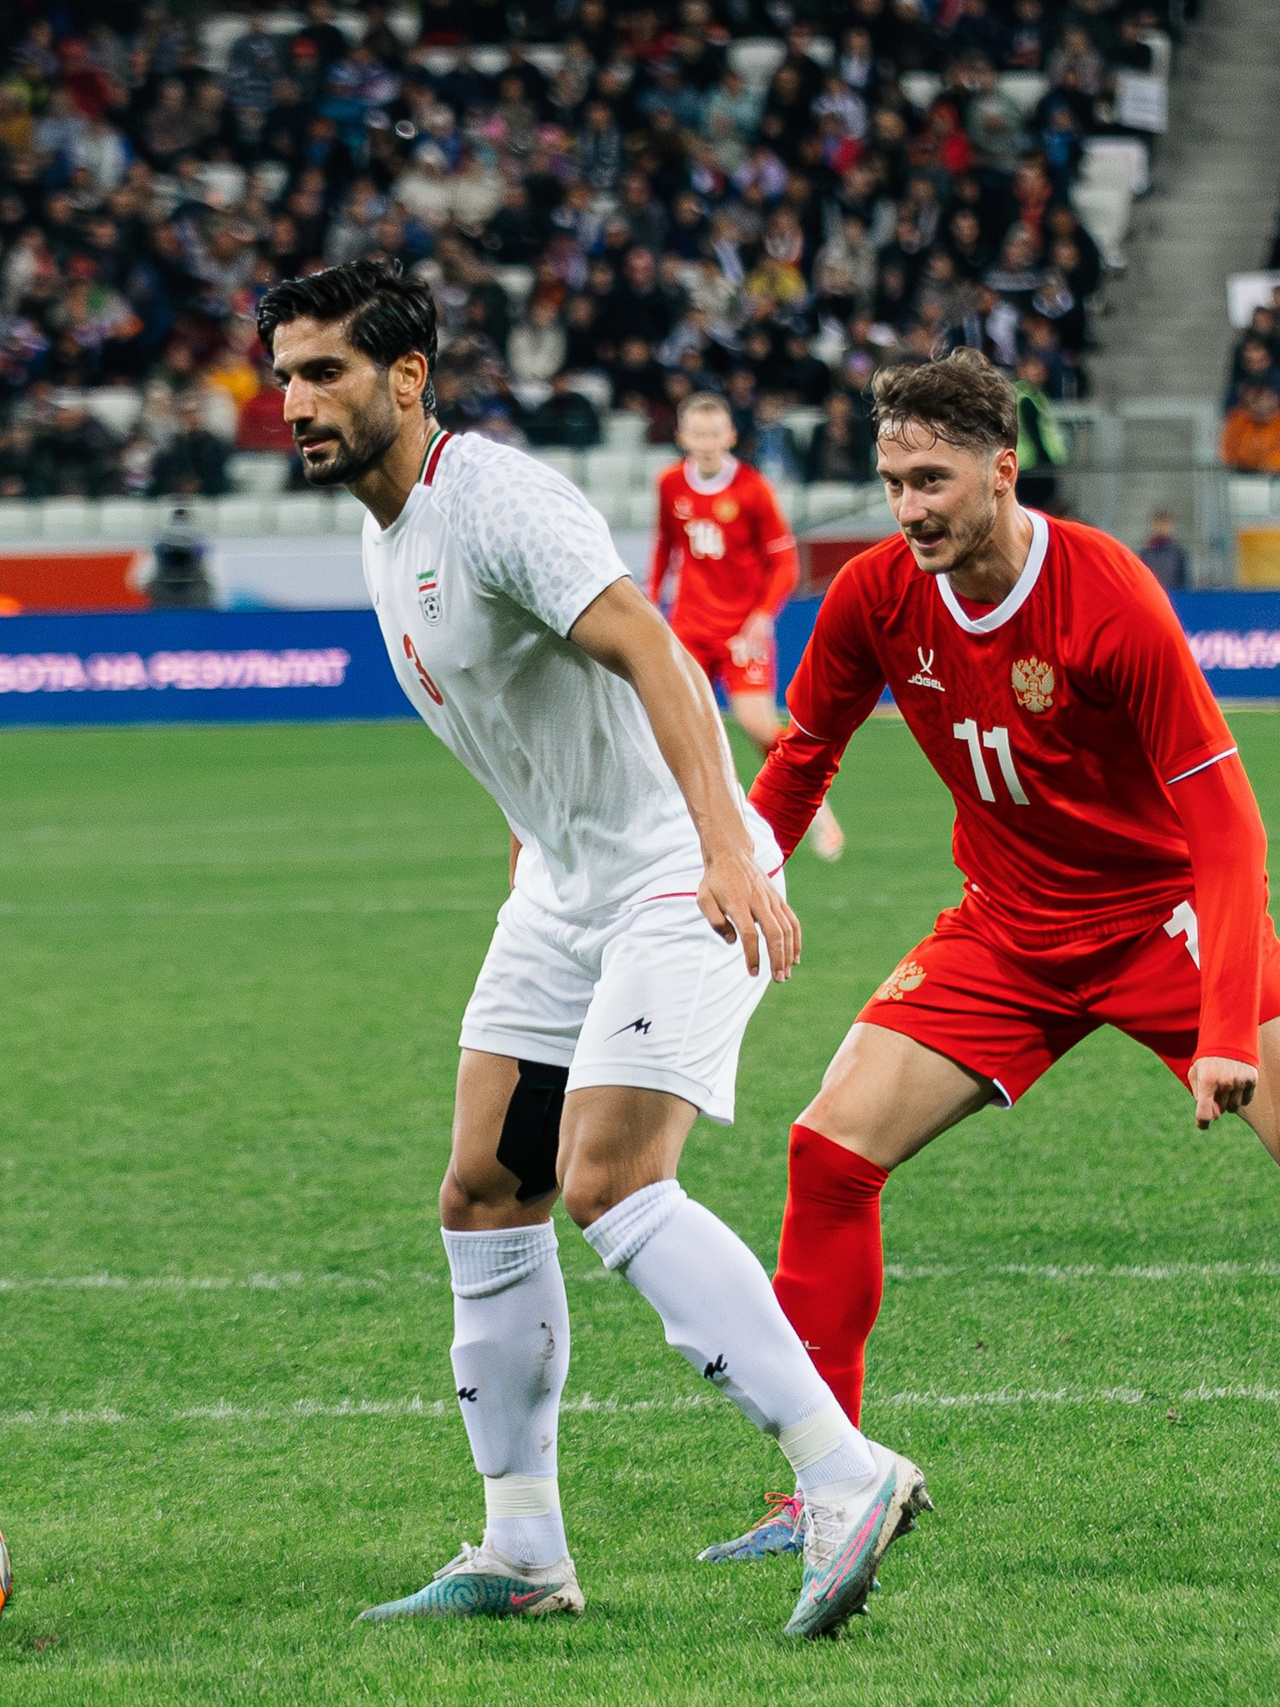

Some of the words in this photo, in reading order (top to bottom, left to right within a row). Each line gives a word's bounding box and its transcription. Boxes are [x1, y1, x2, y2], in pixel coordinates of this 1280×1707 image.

[403, 633, 444, 706] 3
[908, 673, 946, 692] JÖGEL
[953, 717, 1030, 805] 11
